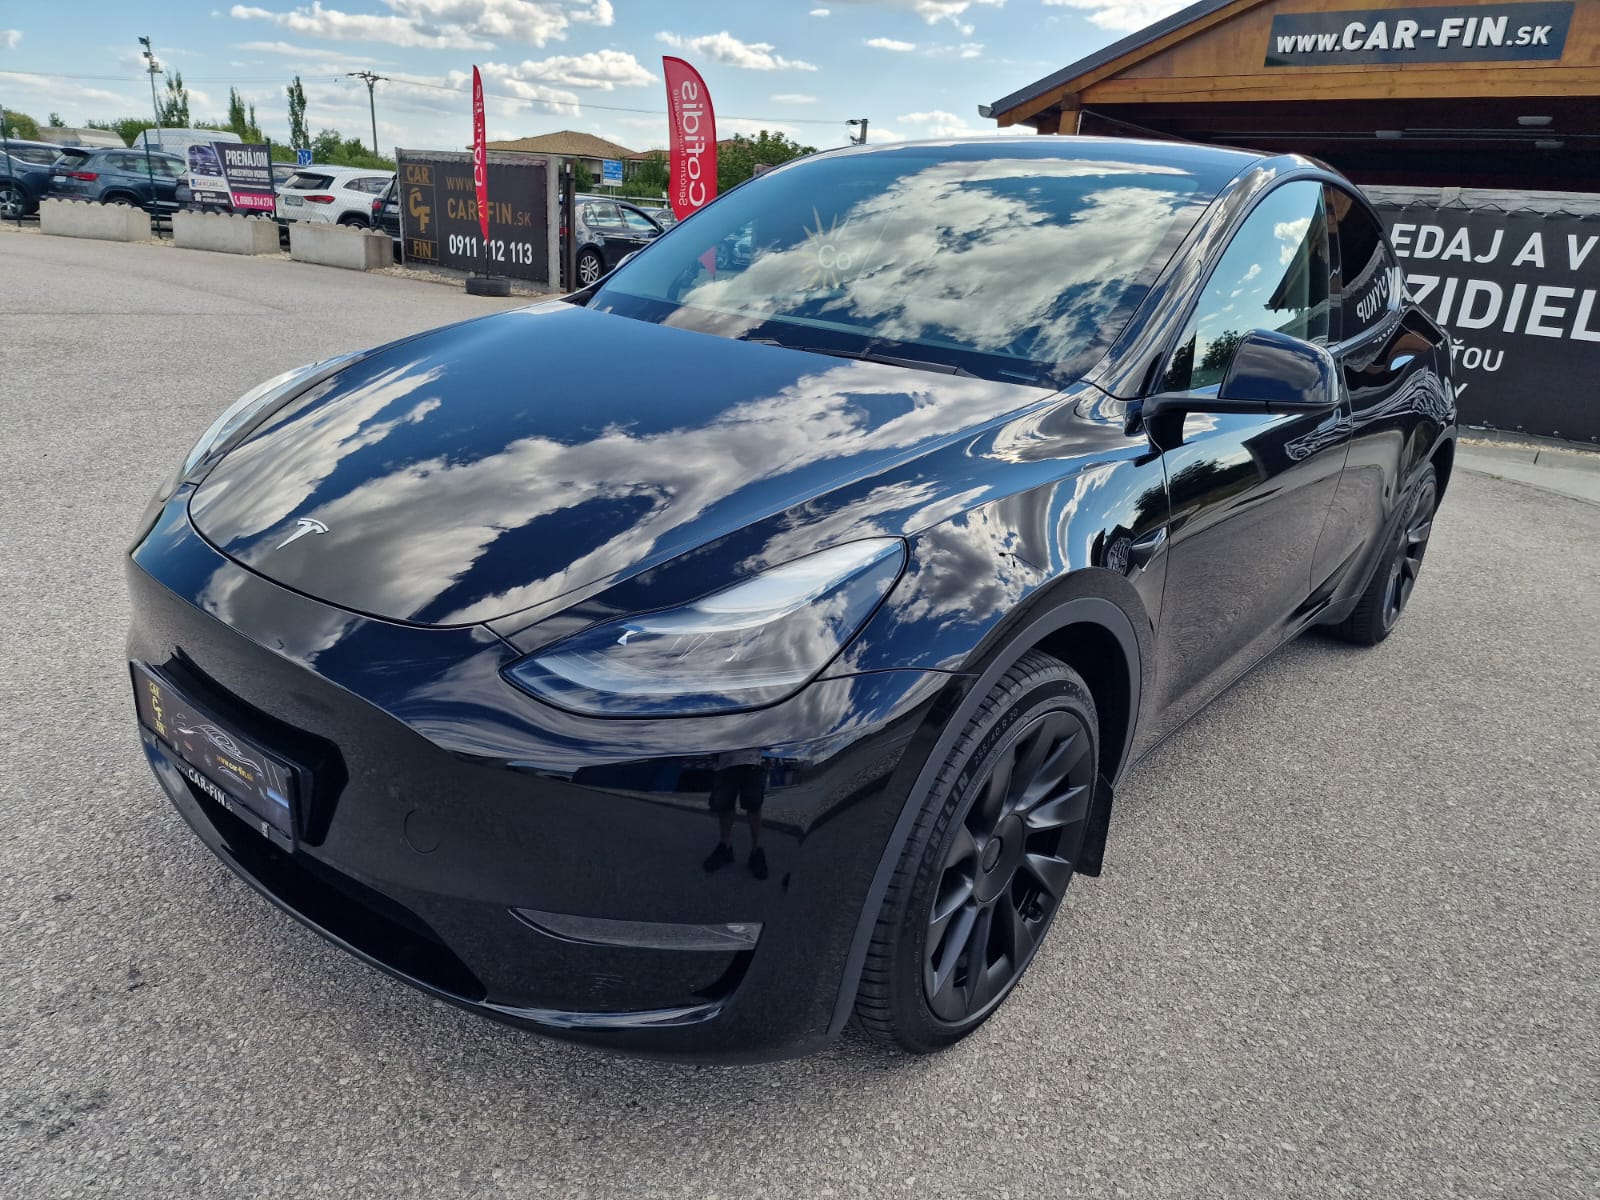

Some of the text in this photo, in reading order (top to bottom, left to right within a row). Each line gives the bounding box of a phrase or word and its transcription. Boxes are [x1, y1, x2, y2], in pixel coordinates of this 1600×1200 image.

[225, 148, 269, 168] PRENÁJOM
[406, 166, 430, 184] CAR
[413, 240, 433, 259] FIN
[449, 233, 533, 265] 0911 112 113
[1511, 231, 1546, 268] A
[912, 771, 970, 900] MICHELIN
